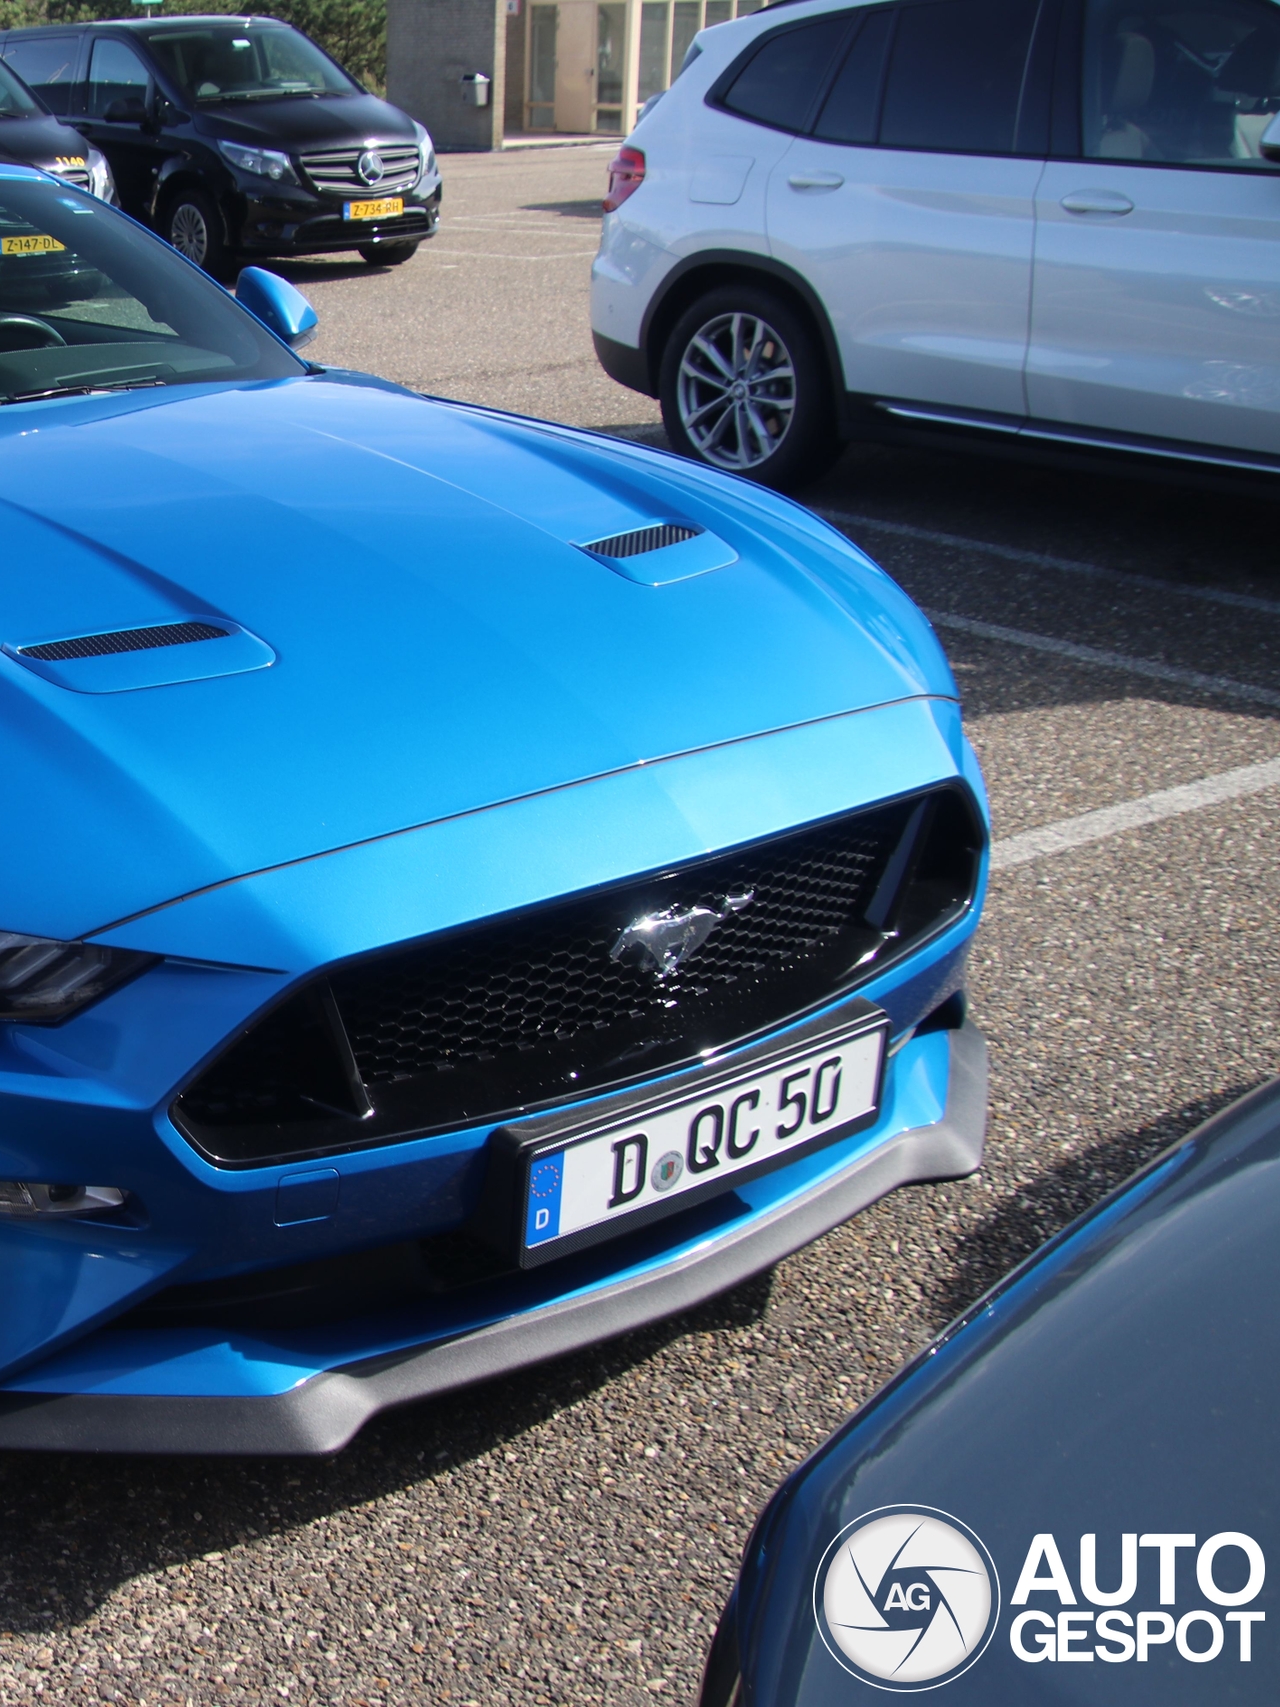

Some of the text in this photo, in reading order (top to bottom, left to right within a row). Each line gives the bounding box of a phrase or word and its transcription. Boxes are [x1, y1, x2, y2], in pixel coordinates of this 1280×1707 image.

[353, 201, 399, 216] Z-734-RH
[6, 238, 59, 252] Z-147-DL
[607, 1133, 648, 1210] D
[687, 1088, 761, 1174] QC
[776, 1055, 843, 1140] 50
[534, 1207, 550, 1230] D
